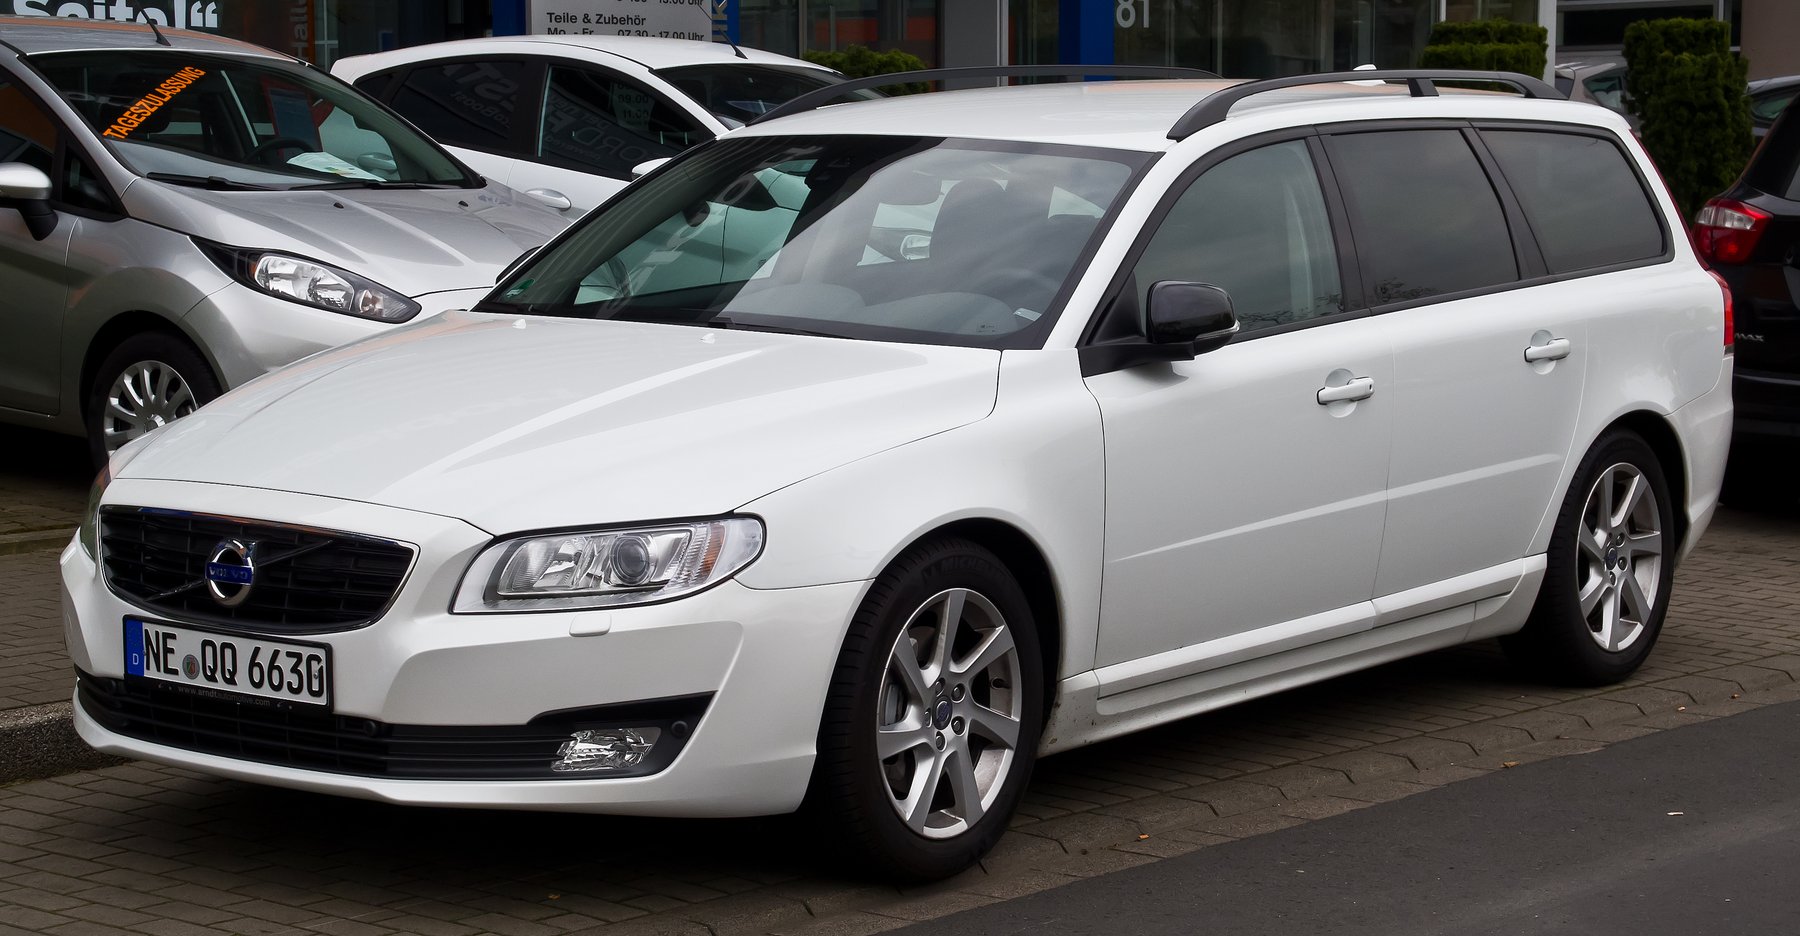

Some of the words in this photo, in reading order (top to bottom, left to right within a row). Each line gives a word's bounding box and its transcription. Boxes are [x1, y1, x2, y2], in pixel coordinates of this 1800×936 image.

[546, 12, 578, 24] Teile
[582, 13, 592, 24] &
[595, 13, 647, 26] Zubehör
[617, 29, 649, 38] 0730
[658, 31, 685, 40] 1700
[688, 32, 705, 42] Uhr
[102, 66, 207, 139] TAGESZULASSUNG
[208, 566, 249, 581] VOLVO
[132, 653, 140, 666] D
[144, 628, 179, 676] NE
[200, 638, 238, 686] QQ
[248, 646, 324, 698] 6630
